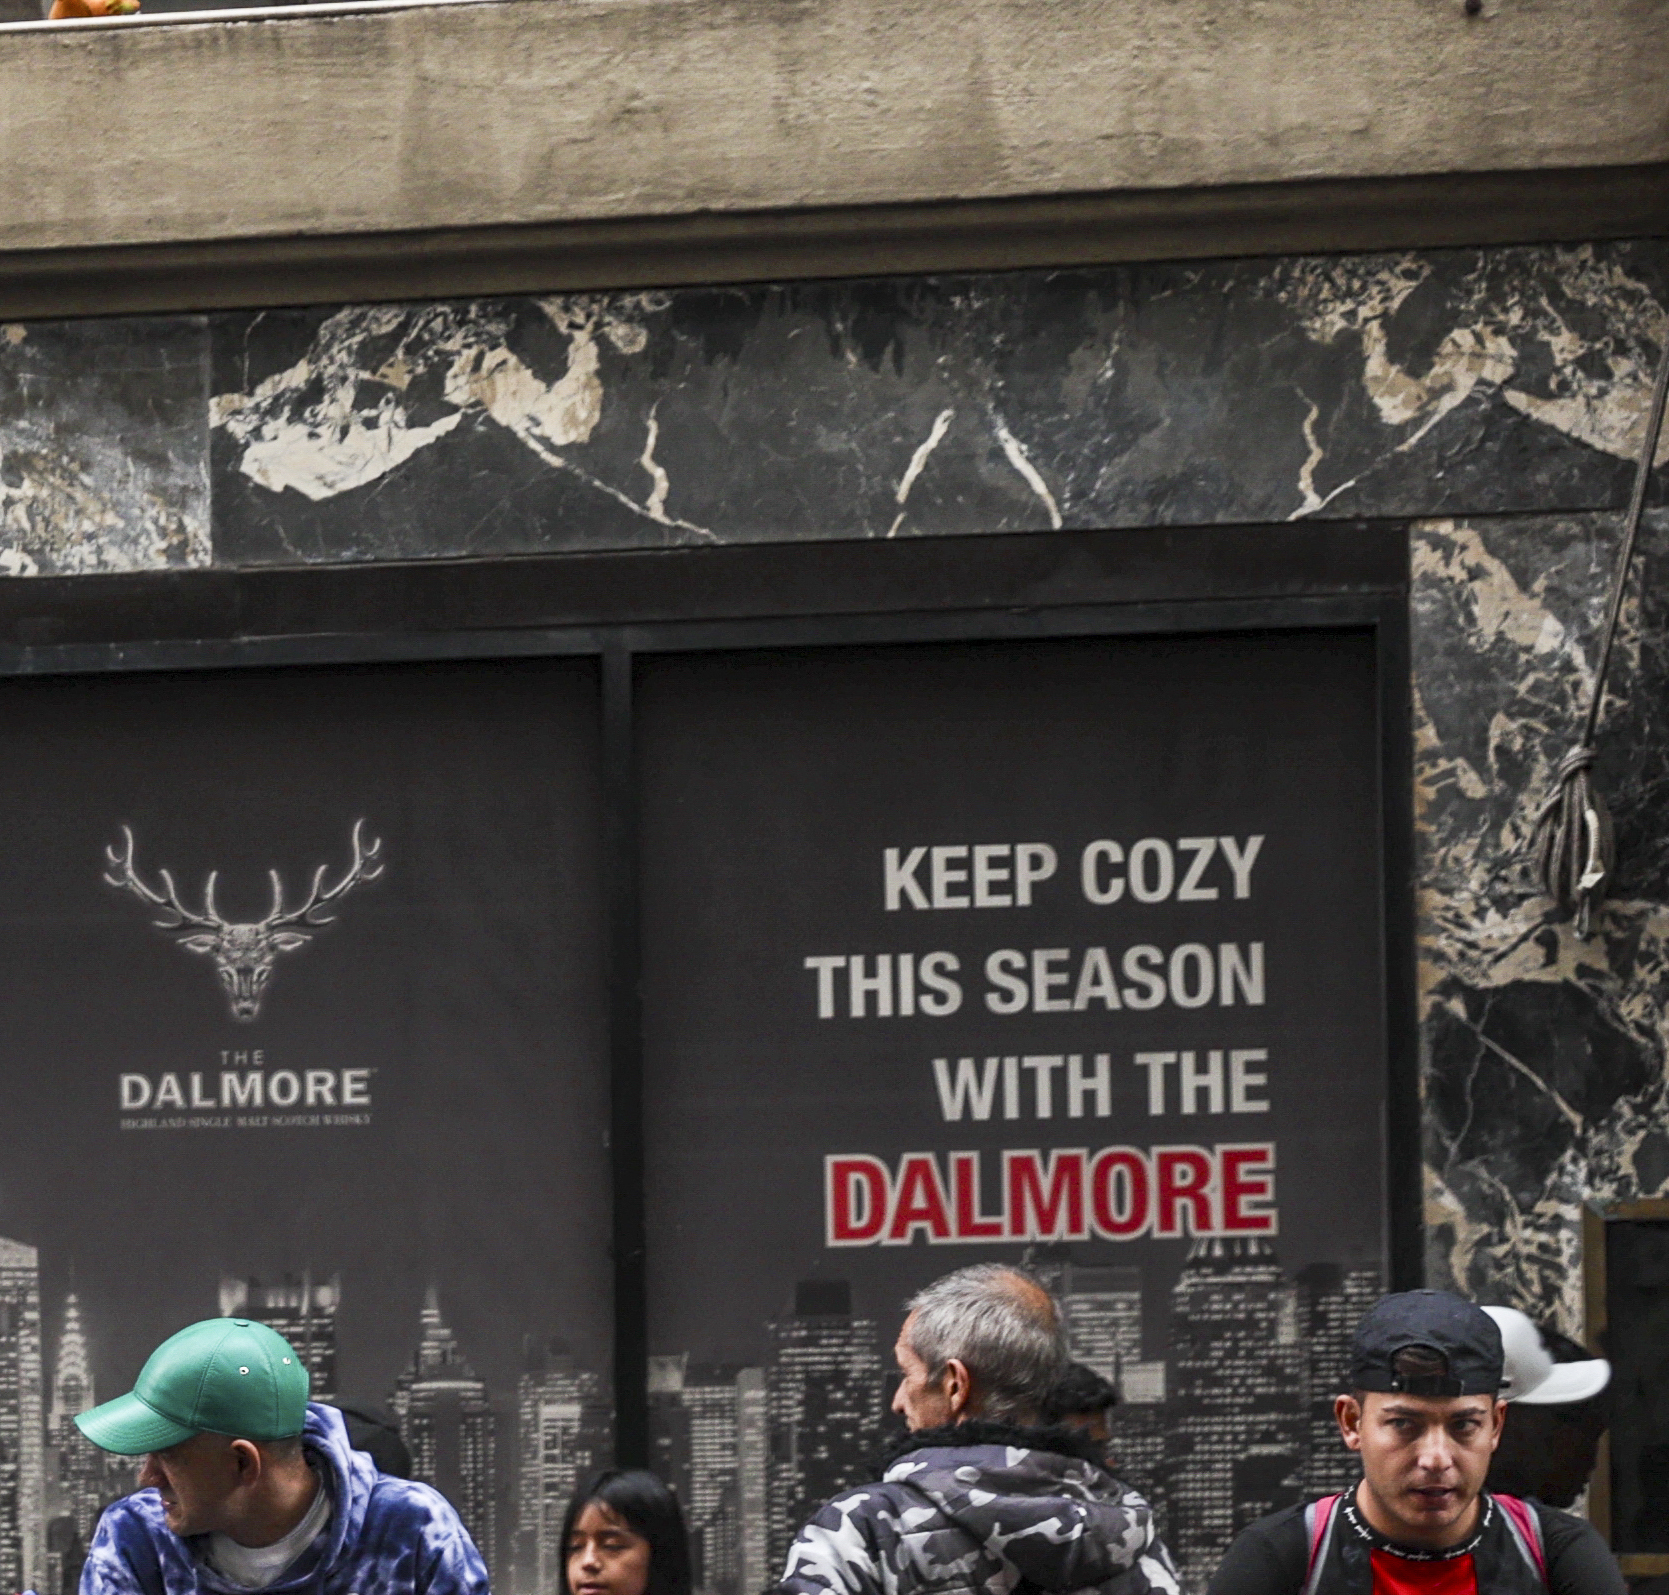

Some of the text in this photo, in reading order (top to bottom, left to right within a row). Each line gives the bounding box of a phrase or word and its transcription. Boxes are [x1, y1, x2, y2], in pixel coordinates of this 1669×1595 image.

[883, 834, 1264, 910] KEEP COZY
[804, 942, 1266, 1019] THIS SEASON
[119, 1067, 372, 1110] DALMORE
[220, 1050, 265, 1066] THE
[933, 1048, 1270, 1121] WITH THE
[824, 1141, 1278, 1247] DALMORE
